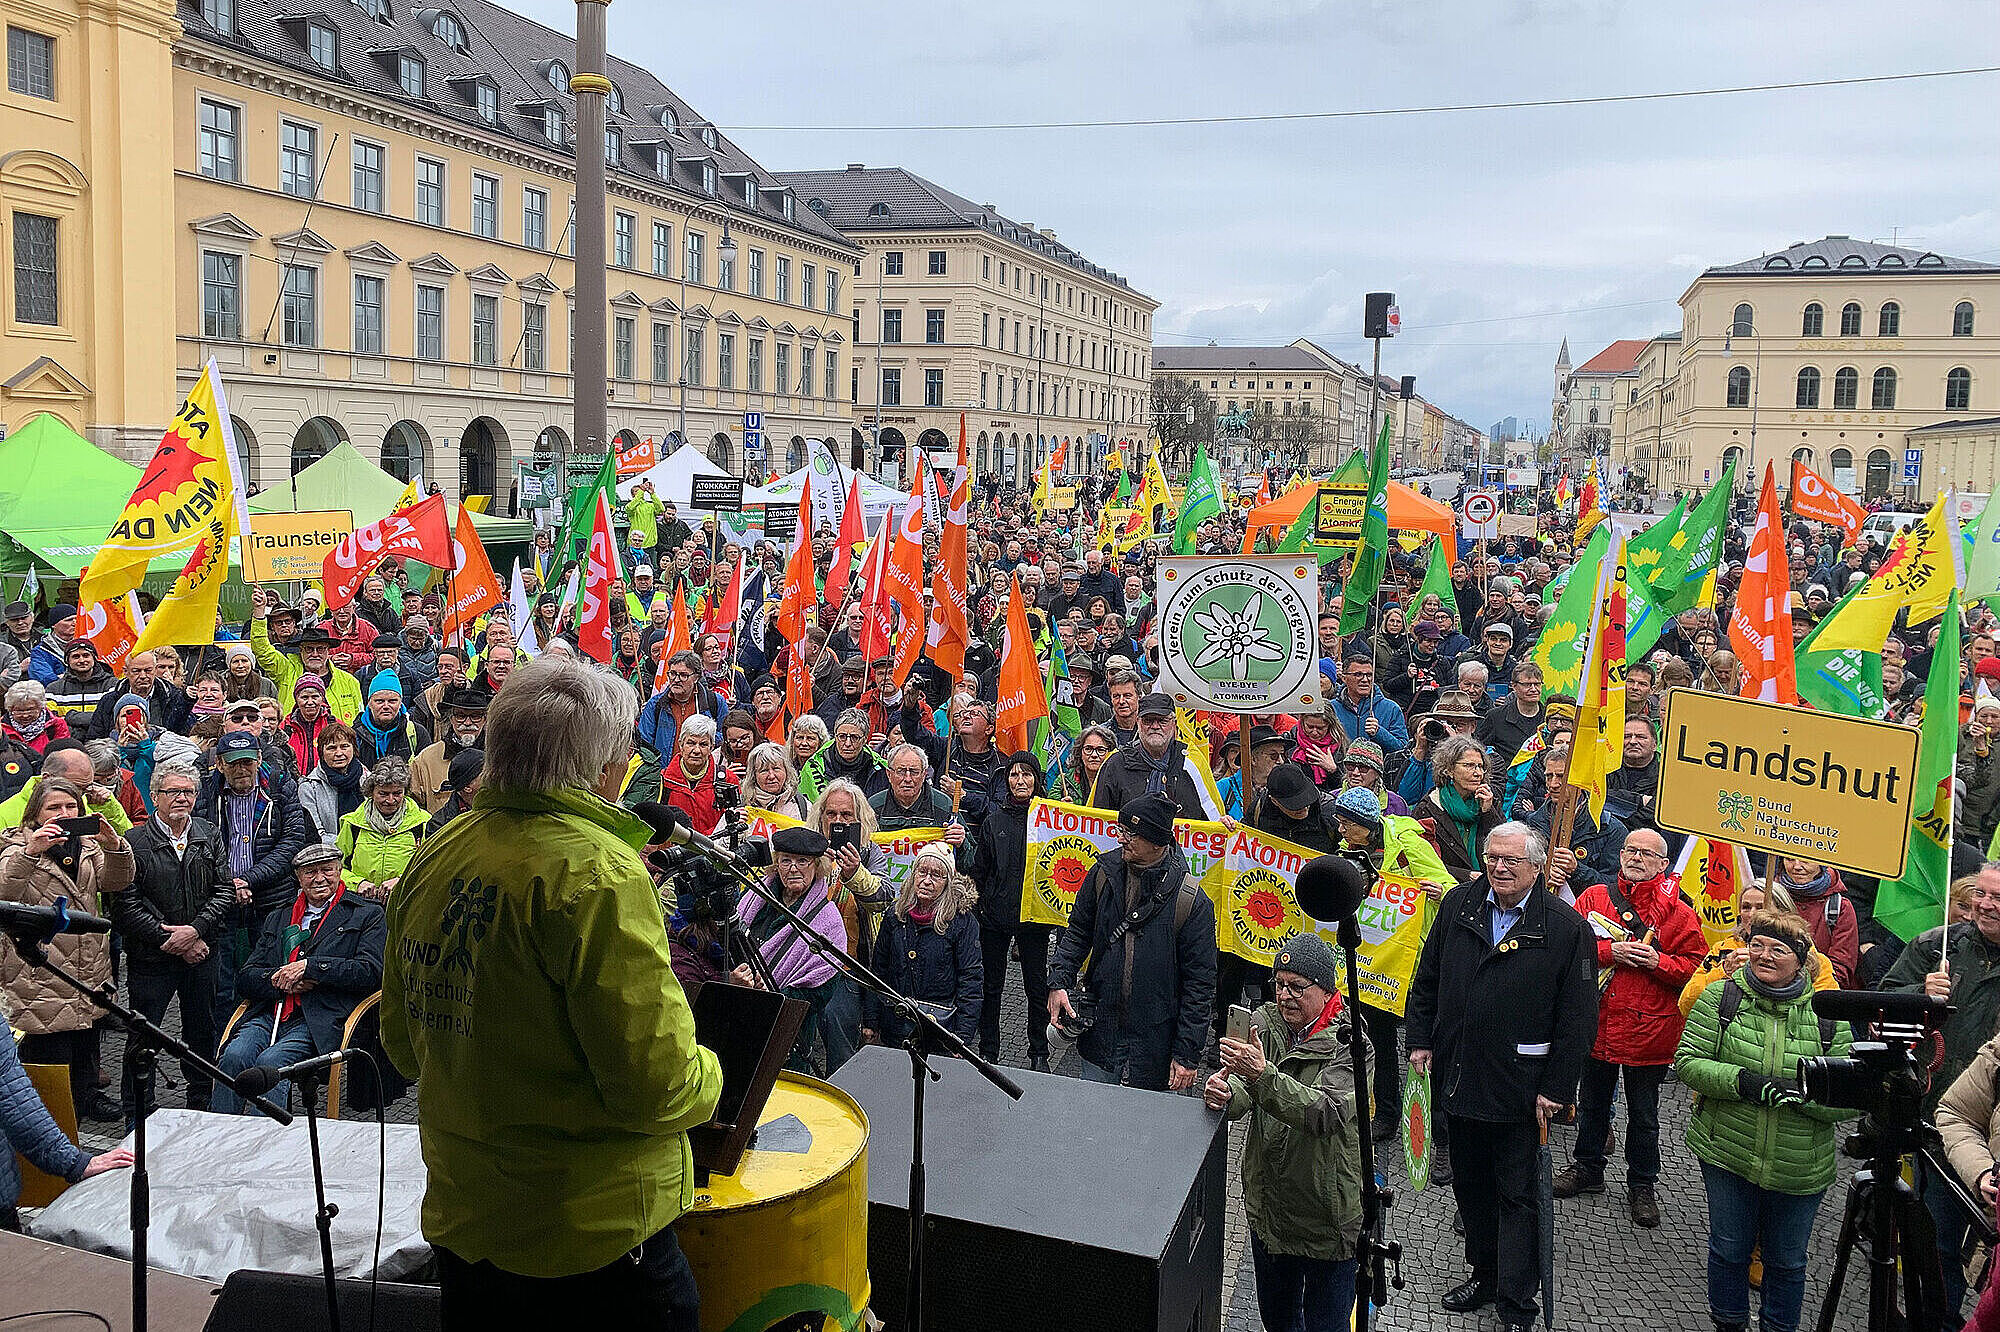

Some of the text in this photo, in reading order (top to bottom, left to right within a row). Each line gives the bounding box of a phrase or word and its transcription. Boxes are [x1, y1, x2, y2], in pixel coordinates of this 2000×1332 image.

[748, 414, 758, 428] U
[863, 415, 916, 423] CUPRA
[1907, 451, 1916, 461] U
[1333, 497, 1364, 507] Energie
[1335, 507, 1362, 515] wende
[1168, 570, 1308, 661] Verein zum Schutz der Bergwelt
[1825, 656, 1859, 682] DIE
[1213, 693, 1268, 701] ATOMKRAFT
[1219, 681, 1258, 689] BYE-BYE
[1676, 724, 1900, 804] Landshut
[1757, 797, 1792, 813] Bund
[1756, 811, 1839, 838] Naturschutz
[1754, 825, 1838, 853] in Bayern e.V.
[1231, 831, 1312, 874] Atom
[1037, 879, 1064, 911] NEIN
[1234, 869, 1301, 918] ATOMKRAFT?
[1232, 909, 1257, 944] NEIN
